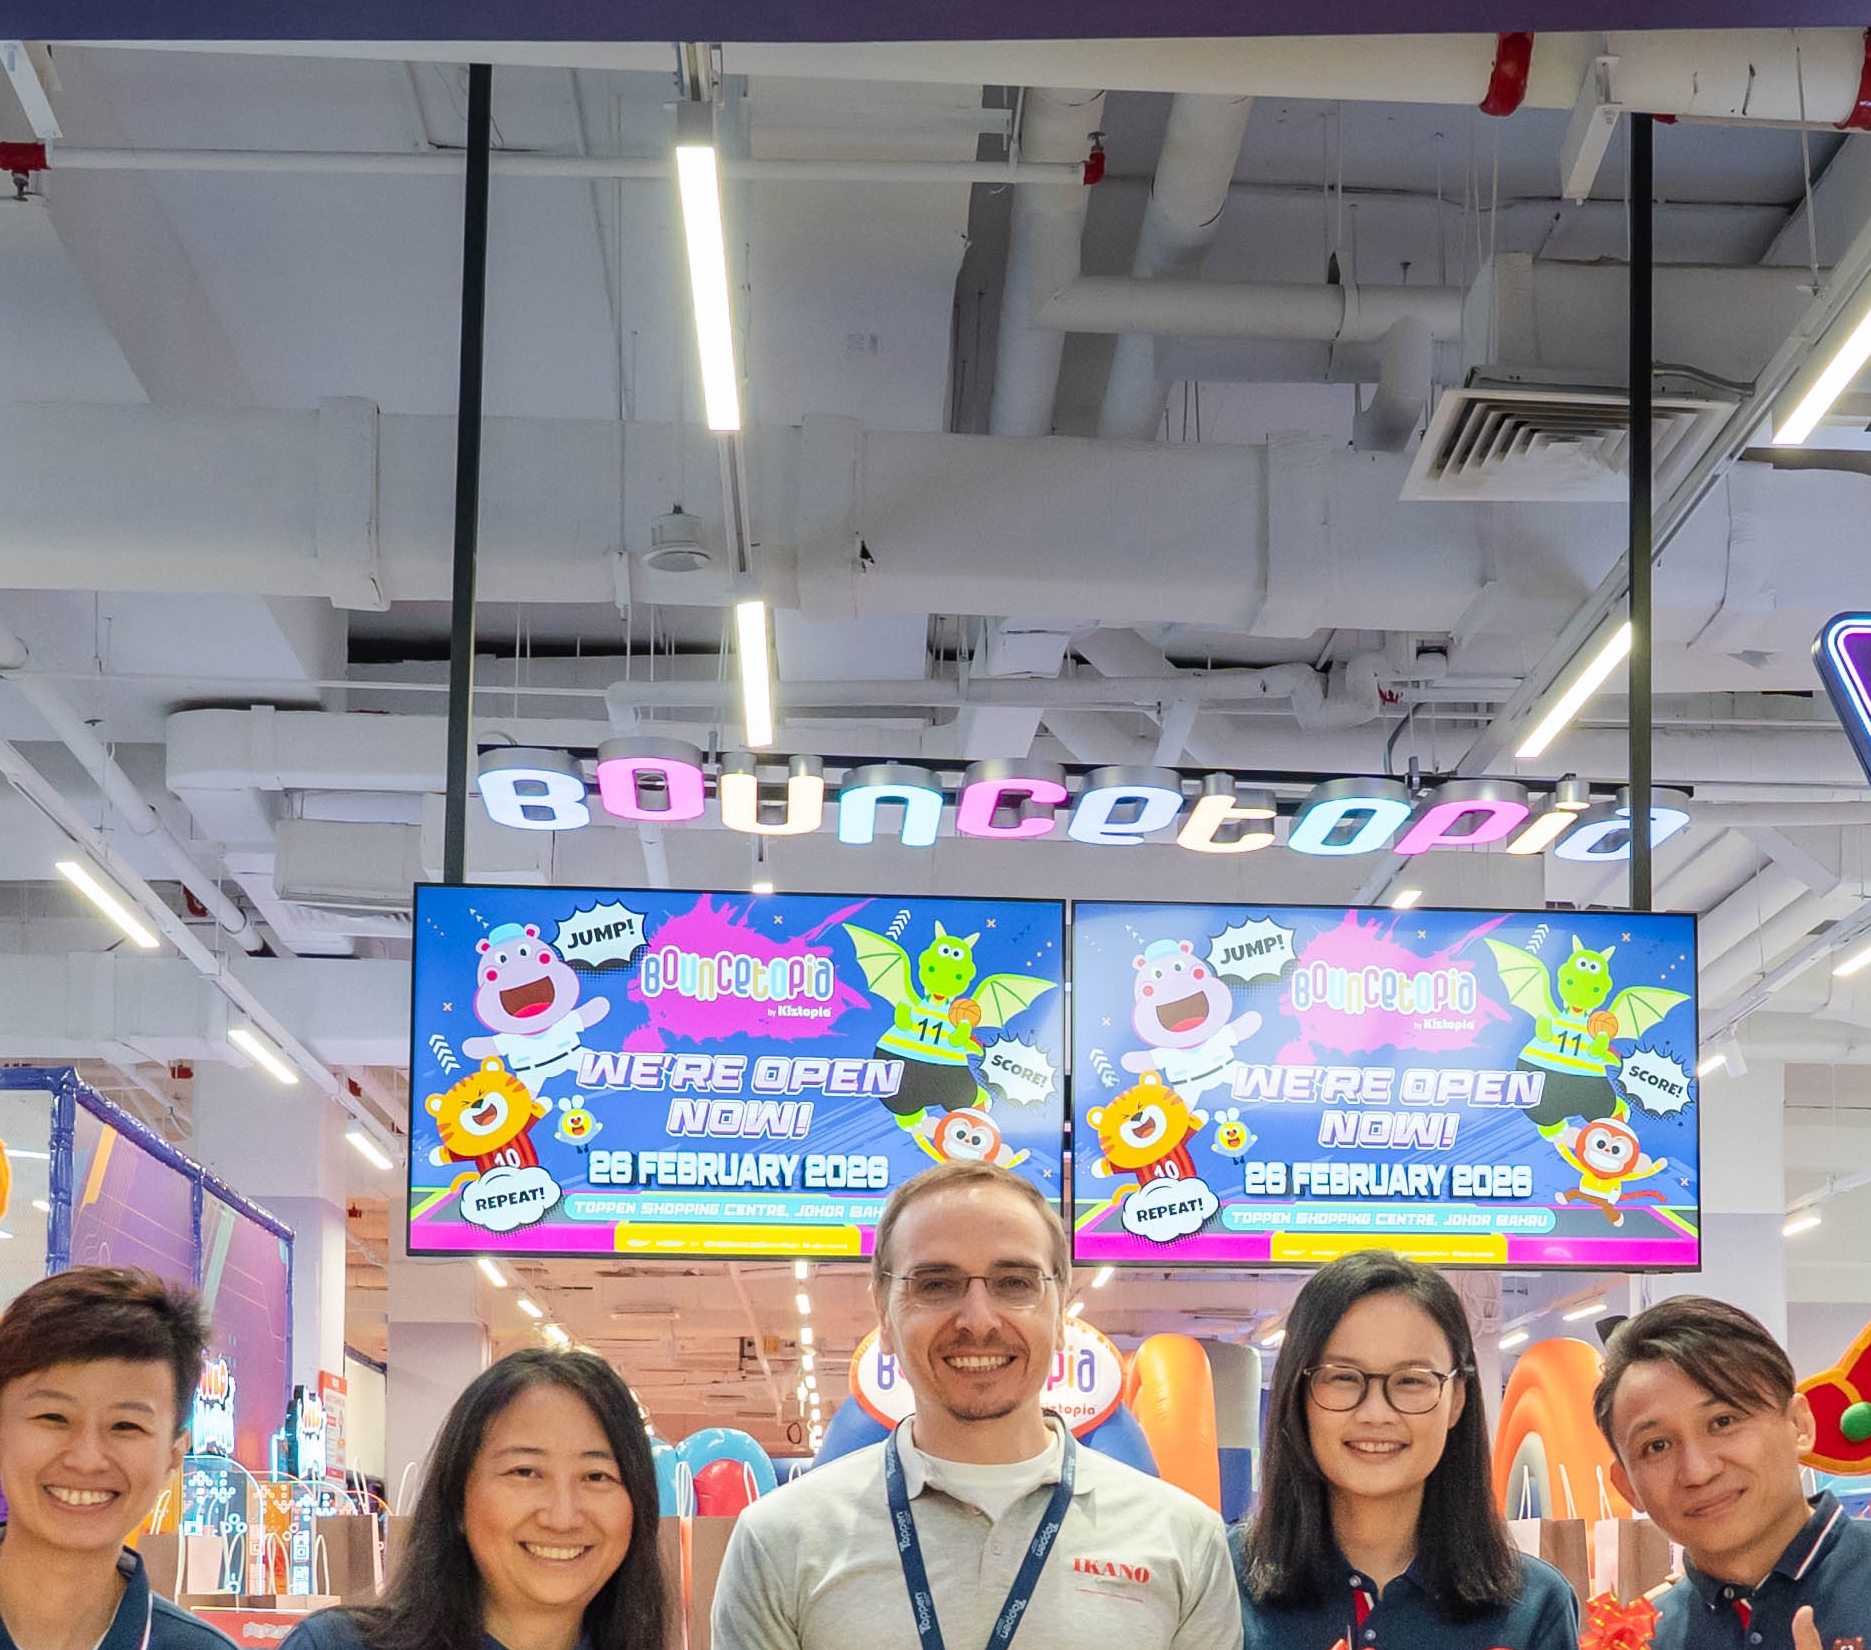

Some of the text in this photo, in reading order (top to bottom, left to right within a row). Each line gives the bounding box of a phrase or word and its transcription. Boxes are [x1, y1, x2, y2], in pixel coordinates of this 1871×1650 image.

[567, 919, 635, 949] JUMP!
[1220, 934, 1284, 964] JUMP!
[918, 1018, 943, 1045] 11
[1558, 1031, 1582, 1056] 11
[577, 1052, 904, 1097] WE'RE OPEN
[991, 1054, 1048, 1088] SCORE!
[1628, 1065, 1683, 1098] SCORE!
[1232, 1066, 1545, 1108] WE'RE OPEN
[666, 1099, 814, 1139] NOW!
[1318, 1110, 1460, 1150] NOW!
[494, 1148, 521, 1168] 10
[589, 1151, 889, 1188] 26 FEBRUARY 2026
[1154, 1160, 1179, 1180] 10
[1292, 1162, 1447, 1197] FEBRUARY
[476, 1187, 545, 1211] REPEAT!
[574, 1201, 883, 1219] TOPPEN SHOPPING CENTRE, JOHOR BAH
[1137, 1198, 1204, 1222] REPEAT!
[1232, 1211, 1547, 1227] TOPPEN SHOPPING CENTRE, JOHOR BAHRU
[1043, 1403, 1095, 1417] topia
[896, 1510, 911, 1551] Toppen
[1035, 1522, 1059, 1557] Toppen
[1073, 1557, 1150, 1584] IKANO
[915, 1591, 931, 1635] Toppen
[1001, 1598, 1027, 1639] Toppen
